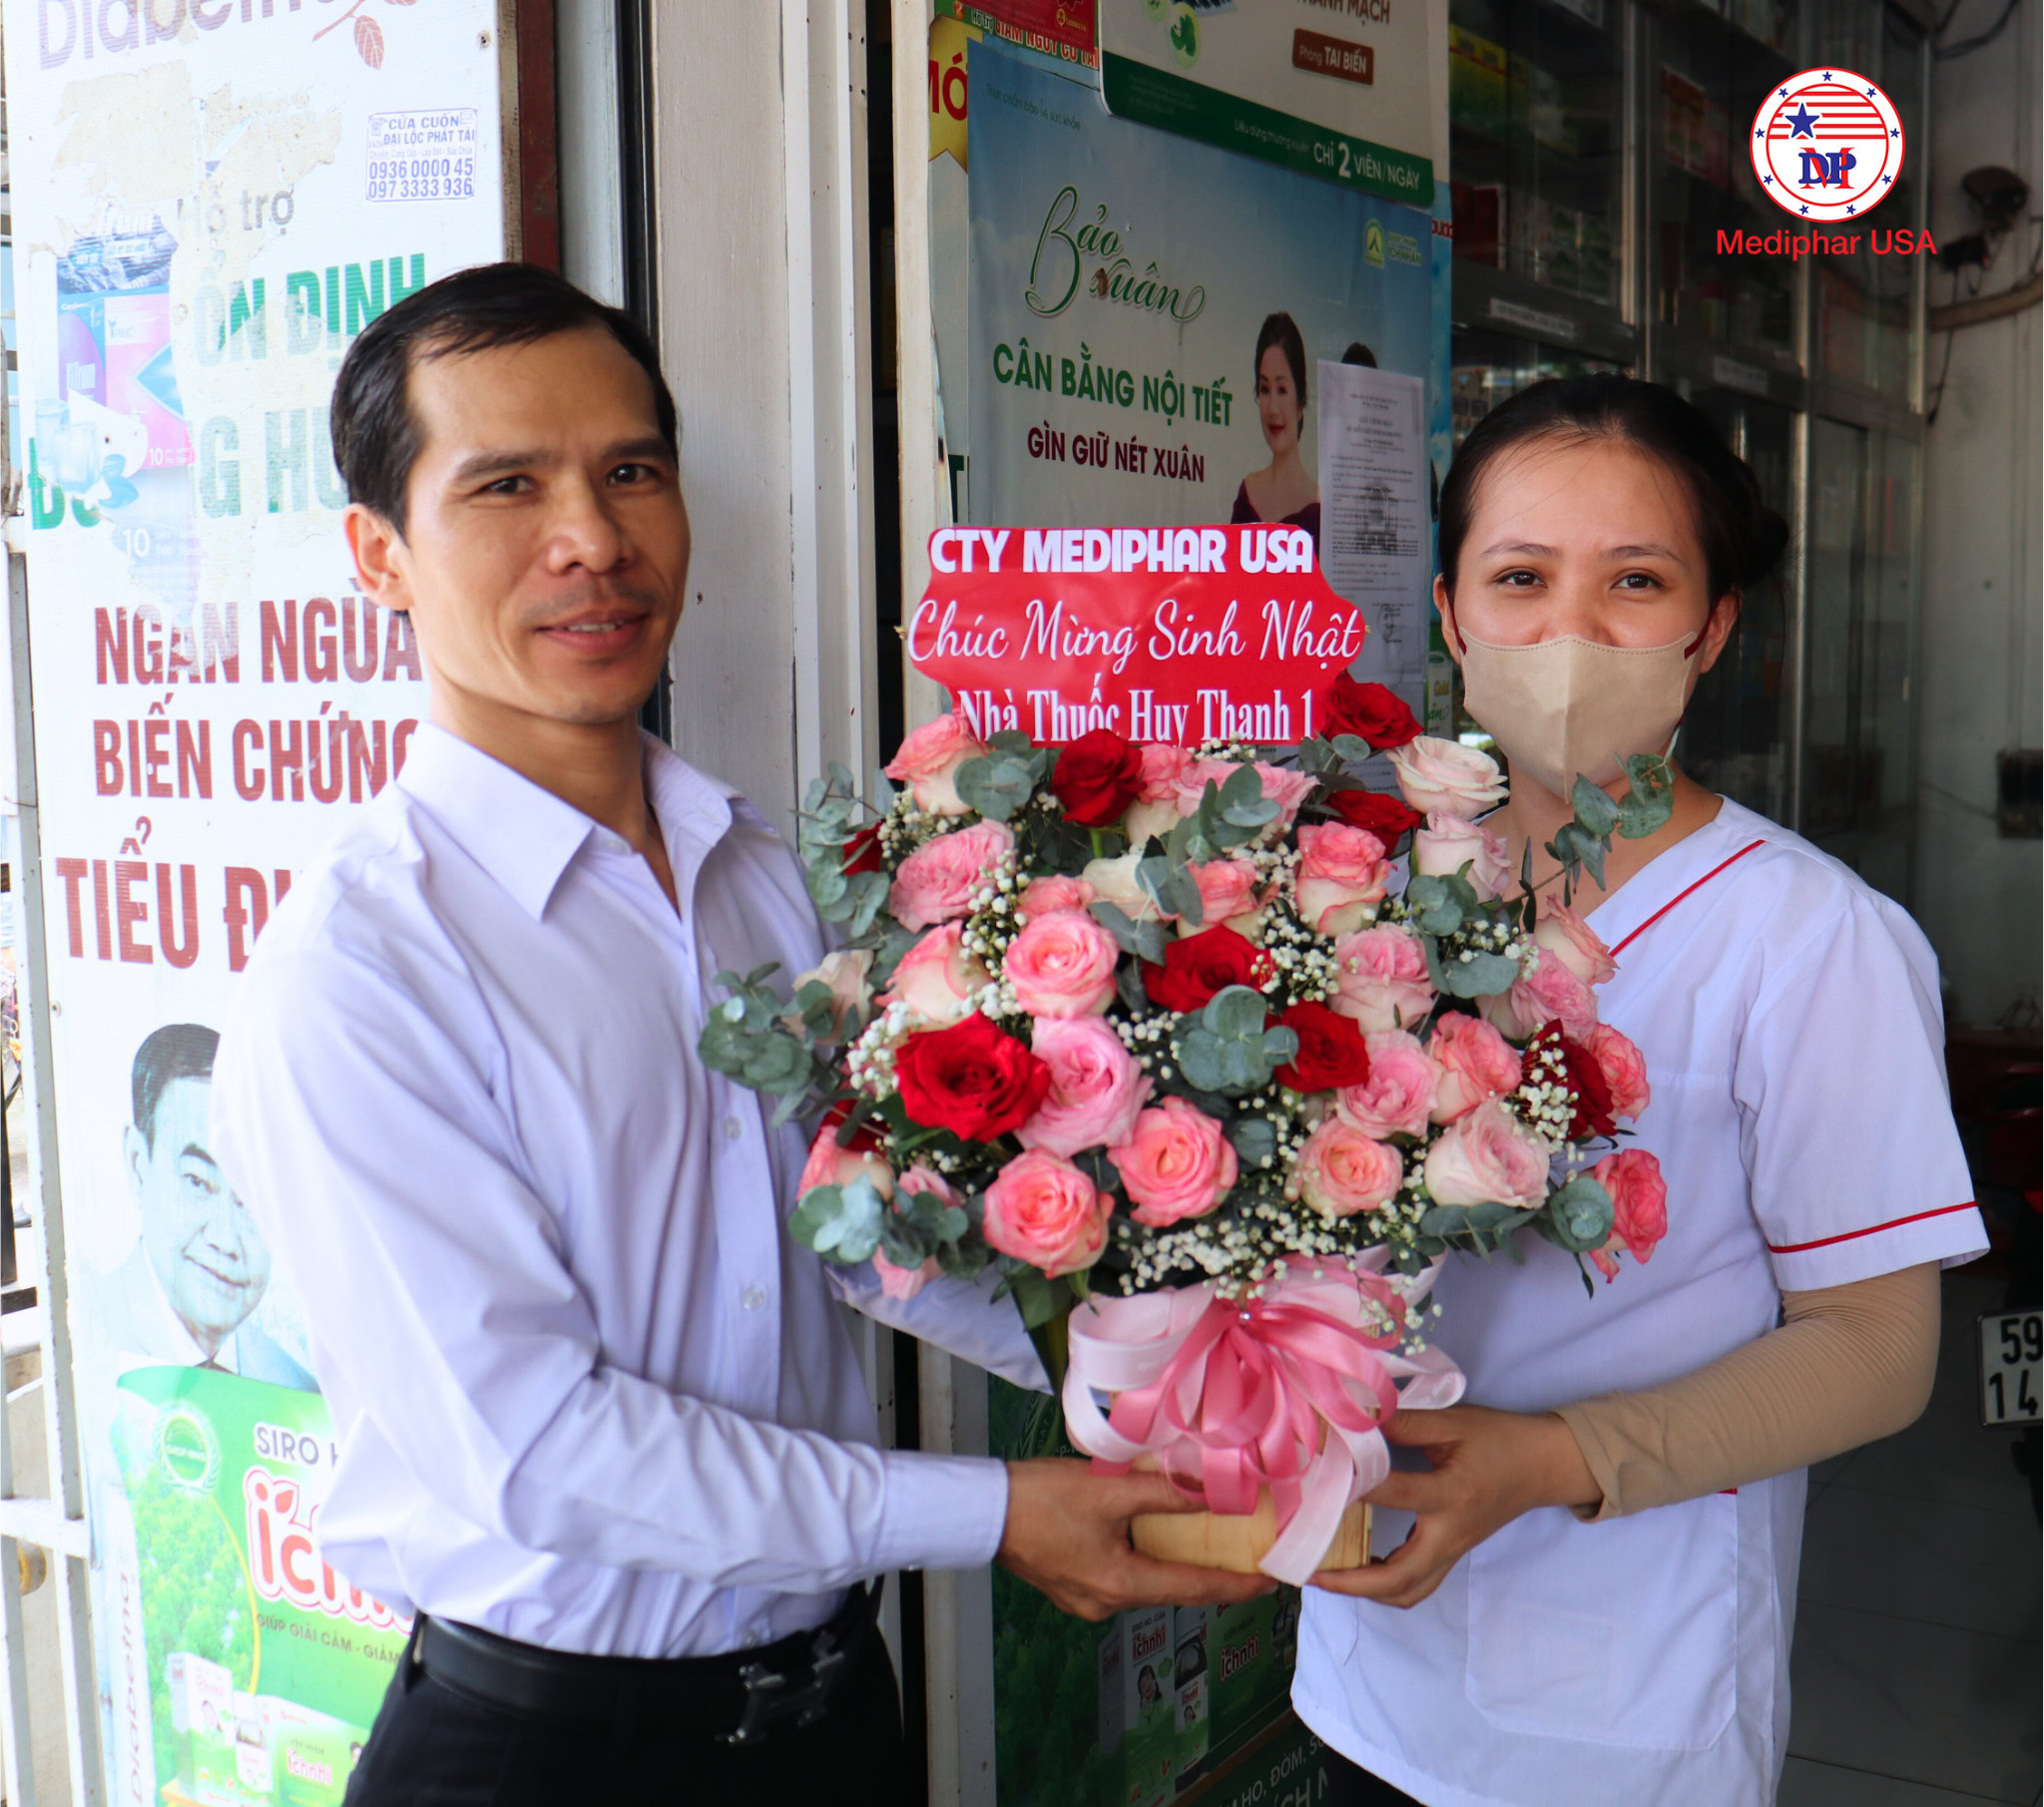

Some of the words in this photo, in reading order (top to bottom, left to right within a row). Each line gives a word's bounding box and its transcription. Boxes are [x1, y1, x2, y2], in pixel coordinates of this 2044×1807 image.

[1324, 46, 1341, 68] TAI
[1343, 48, 1367, 74] BIẾN
[404, 129, 424, 147] LỘC
[1337, 141, 1351, 178] 2
[368, 180, 397, 199] 097
[400, 179, 439, 198] 3333
[443, 178, 473, 197] 936
[369, 161, 407, 180] 0936
[411, 159, 450, 178] 0000
[454, 158, 473, 177] 45
[241, 183, 294, 235] trợ
[1025, 185, 1123, 316] Bảo
[993, 336, 1052, 392] CÂN
[1061, 340, 1135, 408] BẰNG
[1142, 368, 1186, 427] NỘI
[1192, 375, 1234, 427] TIẾT
[1027, 419, 1066, 462] GÌN
[1071, 430, 1110, 469] GIỮ
[1115, 434, 1148, 474] NÉT
[1153, 443, 1205, 483] XUÂN
[122, 527, 150, 559] 10
[929, 528, 1011, 574] CTY
[1021, 528, 1228, 574] MEDIPHAR
[1238, 528, 1314, 574] USA
[905, 599, 1010, 663] Chúc
[1018, 599, 1140, 675] Mừng
[1148, 599, 1247, 662] Sinh
[1258, 598, 1361, 672] Nhật
[958, 686, 1019, 743] Nhà
[1026, 672, 1120, 743] Thuốc
[1128, 688, 1190, 749] Huy
[1196, 688, 1291, 742] Thanh
[1299, 687, 1315, 742] 1
[93, 690, 214, 800] BIẾN
[55, 815, 201, 970] TIỂU
[1989, 1369, 2039, 1420] 14
[256, 1425, 320, 1467] SIRO
[255, 1611, 287, 1631] GIÚP
